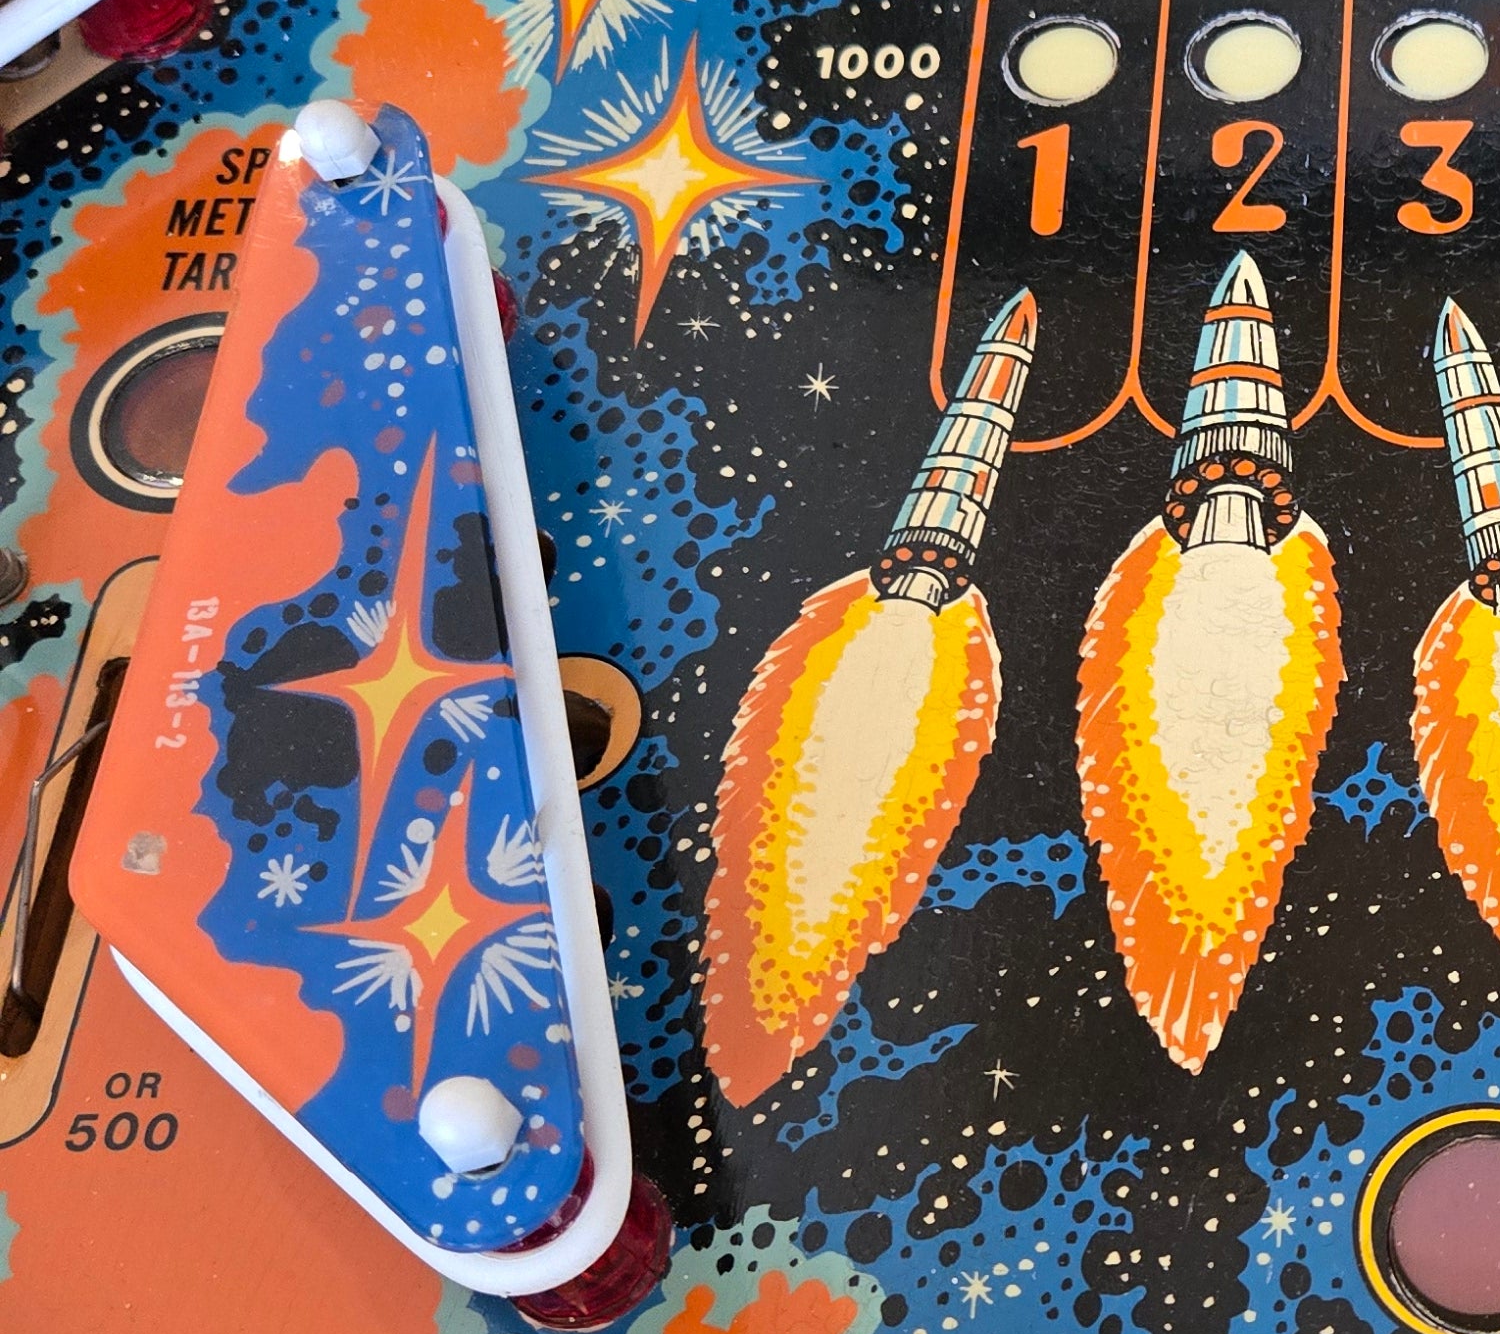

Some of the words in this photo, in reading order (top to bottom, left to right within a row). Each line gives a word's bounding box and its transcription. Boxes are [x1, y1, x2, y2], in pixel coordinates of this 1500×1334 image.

[815, 43, 942, 80] 1000
[216, 148, 272, 185] SP
[1016, 122, 1071, 237] 1
[1210, 119, 1288, 234] 2
[1396, 119, 1475, 236] 3
[165, 198, 256, 237] MET
[162, 252, 239, 291] TAR
[155, 595, 221, 751] 13A-113-2
[104, 1071, 163, 1101] OR
[64, 1111, 180, 1153] 500
